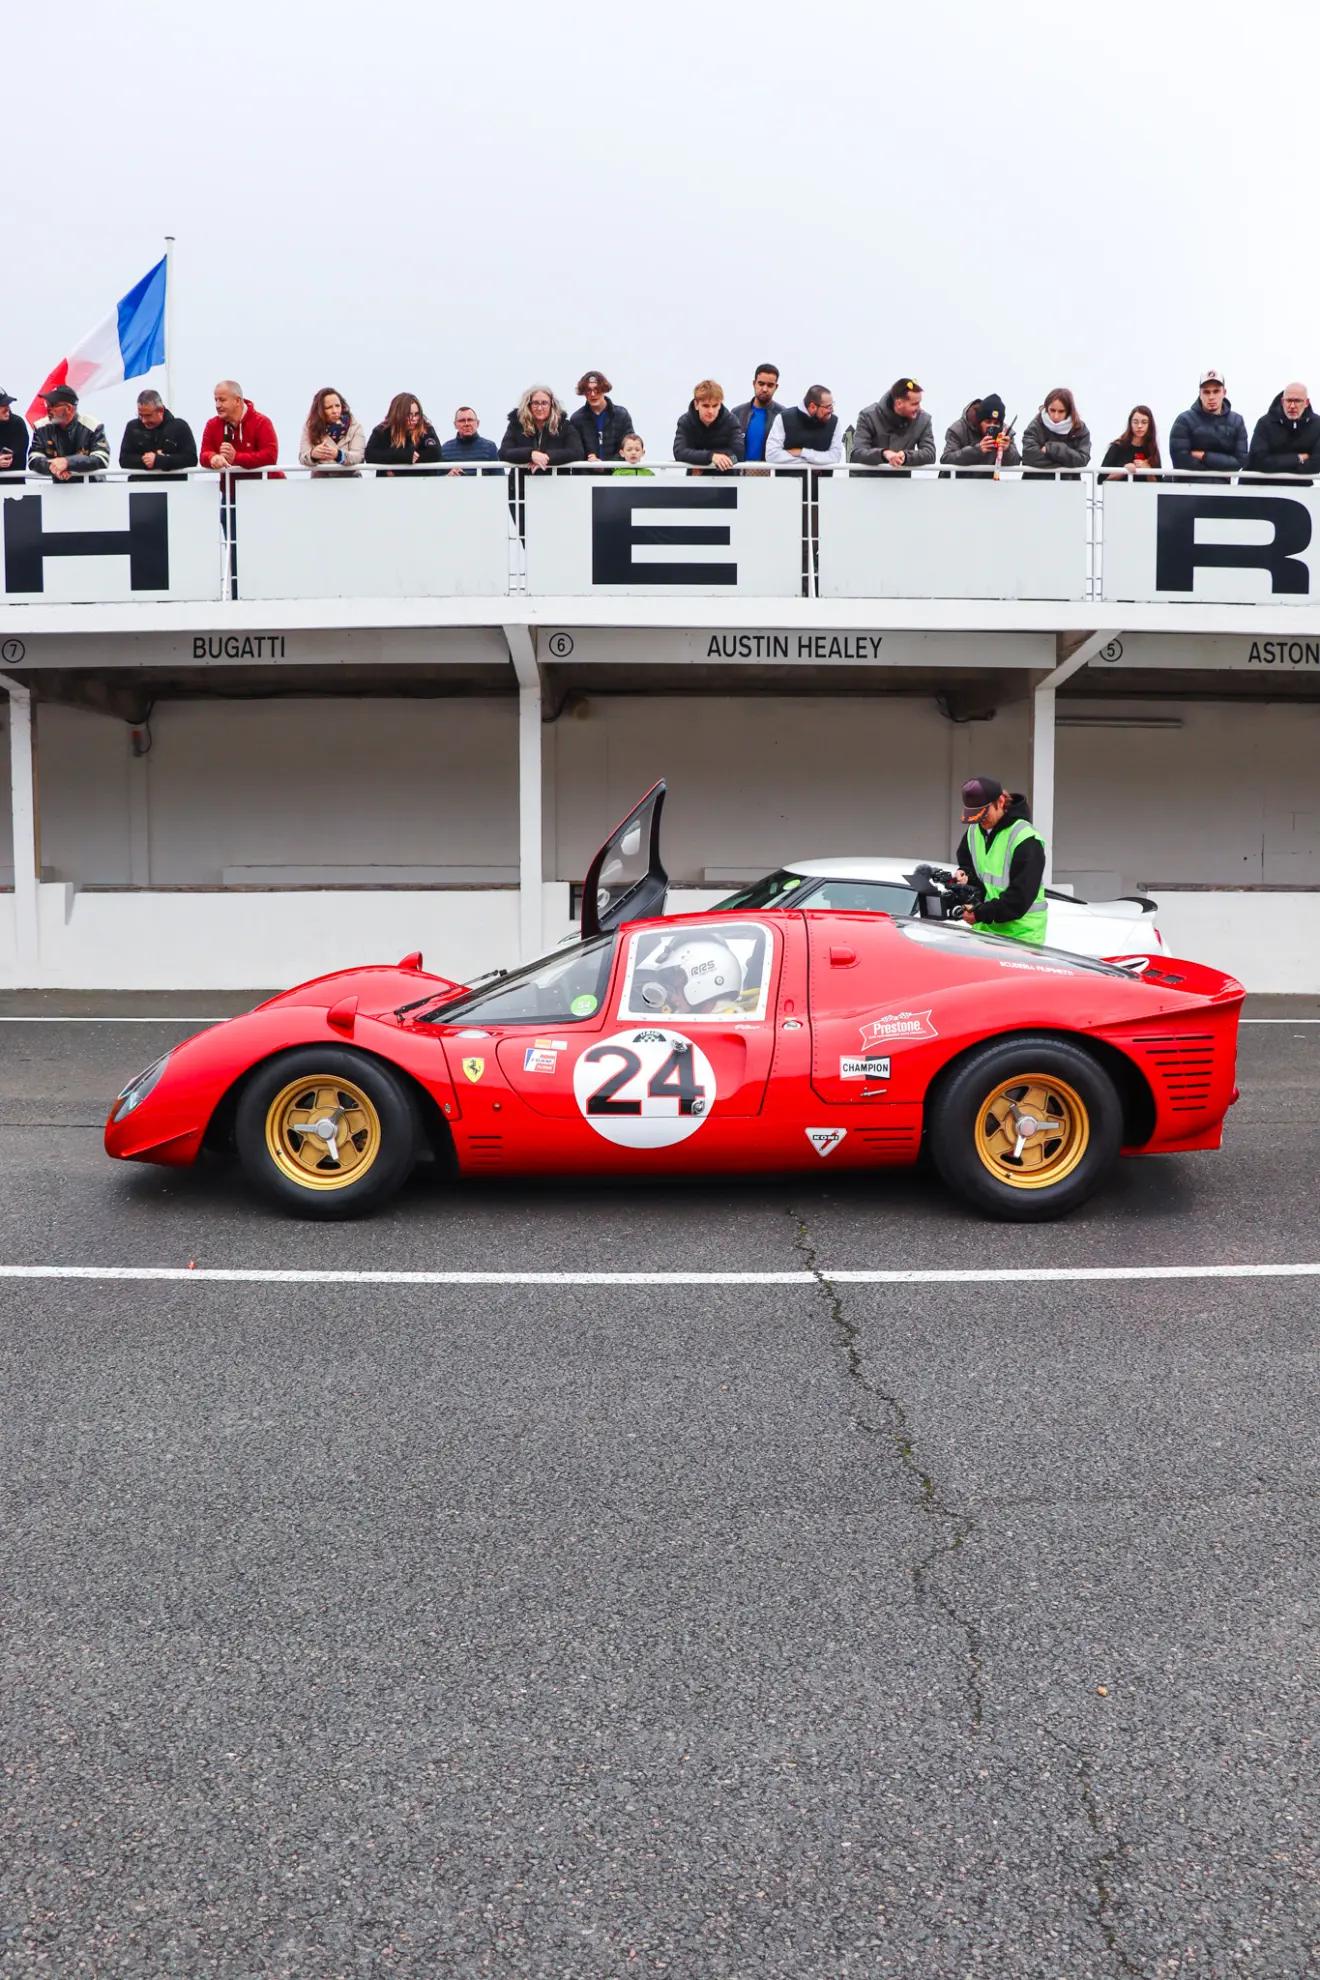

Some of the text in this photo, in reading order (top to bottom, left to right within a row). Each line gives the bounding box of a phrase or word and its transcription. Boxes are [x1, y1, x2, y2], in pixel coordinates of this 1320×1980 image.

[4, 486, 1312, 594] H E R
[193, 636, 285, 659] BUGATTI
[707, 635, 883, 659] AUSTIN HEALEY
[1248, 641, 1320, 664] ASTON
[873, 1020, 921, 1036] Prestone
[584, 1043, 706, 1116] 24
[842, 1063, 889, 1073] CHAMPION
